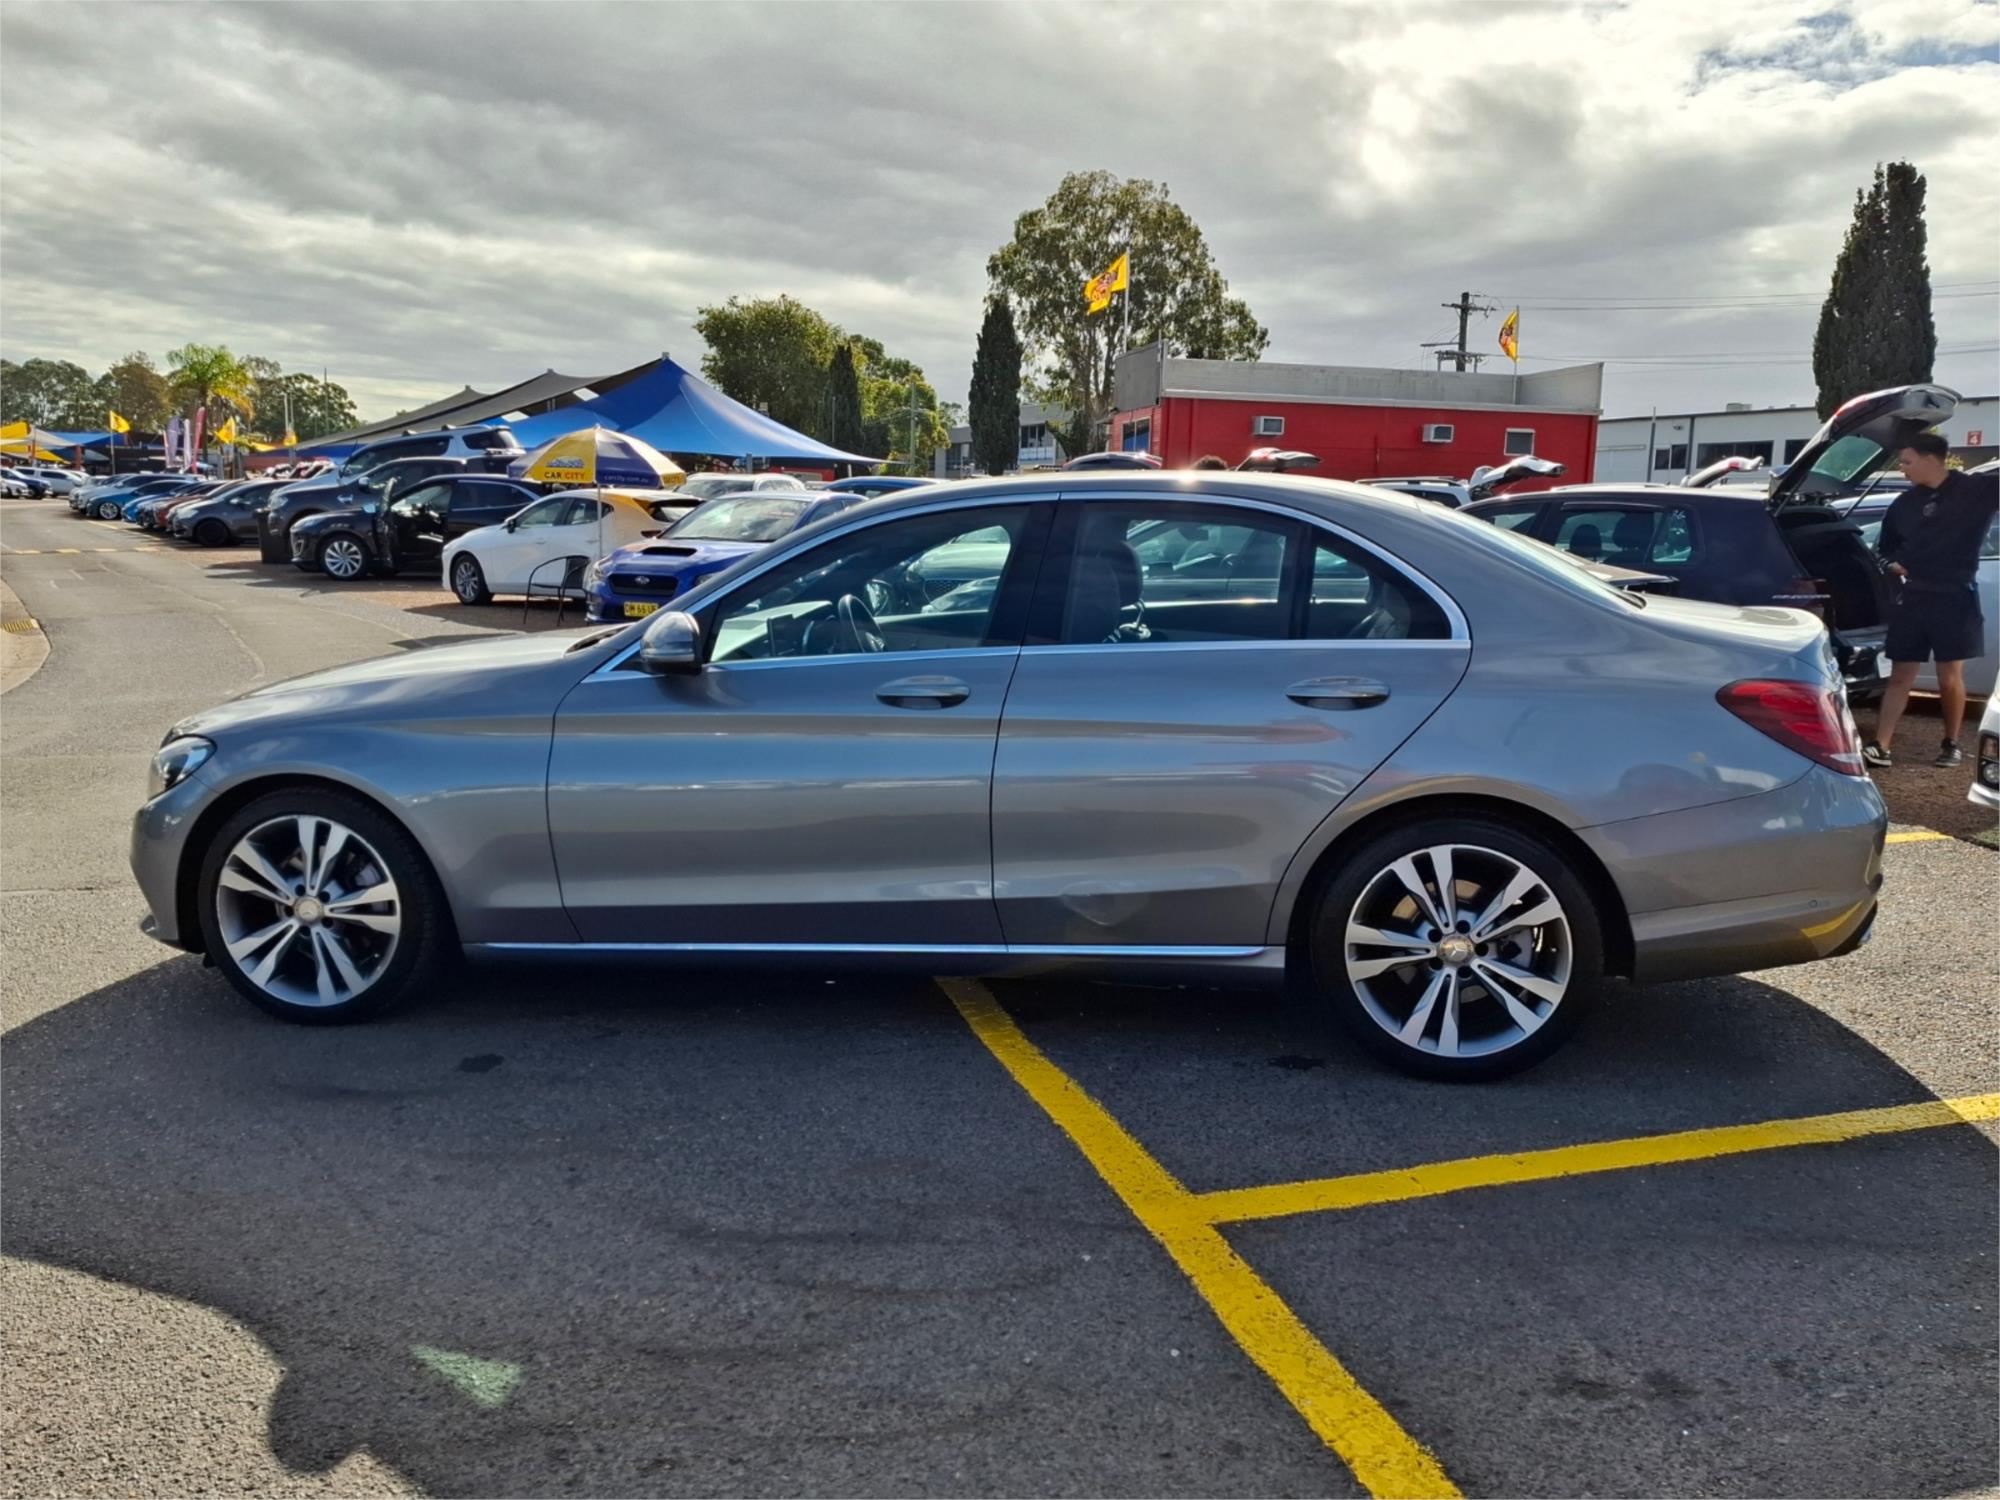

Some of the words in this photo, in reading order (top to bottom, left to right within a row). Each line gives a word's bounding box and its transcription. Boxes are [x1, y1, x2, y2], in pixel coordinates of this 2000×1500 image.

[1970, 434, 1978, 444] 4
[544, 471, 562, 479] CAR
[564, 471, 585, 479] CITY
